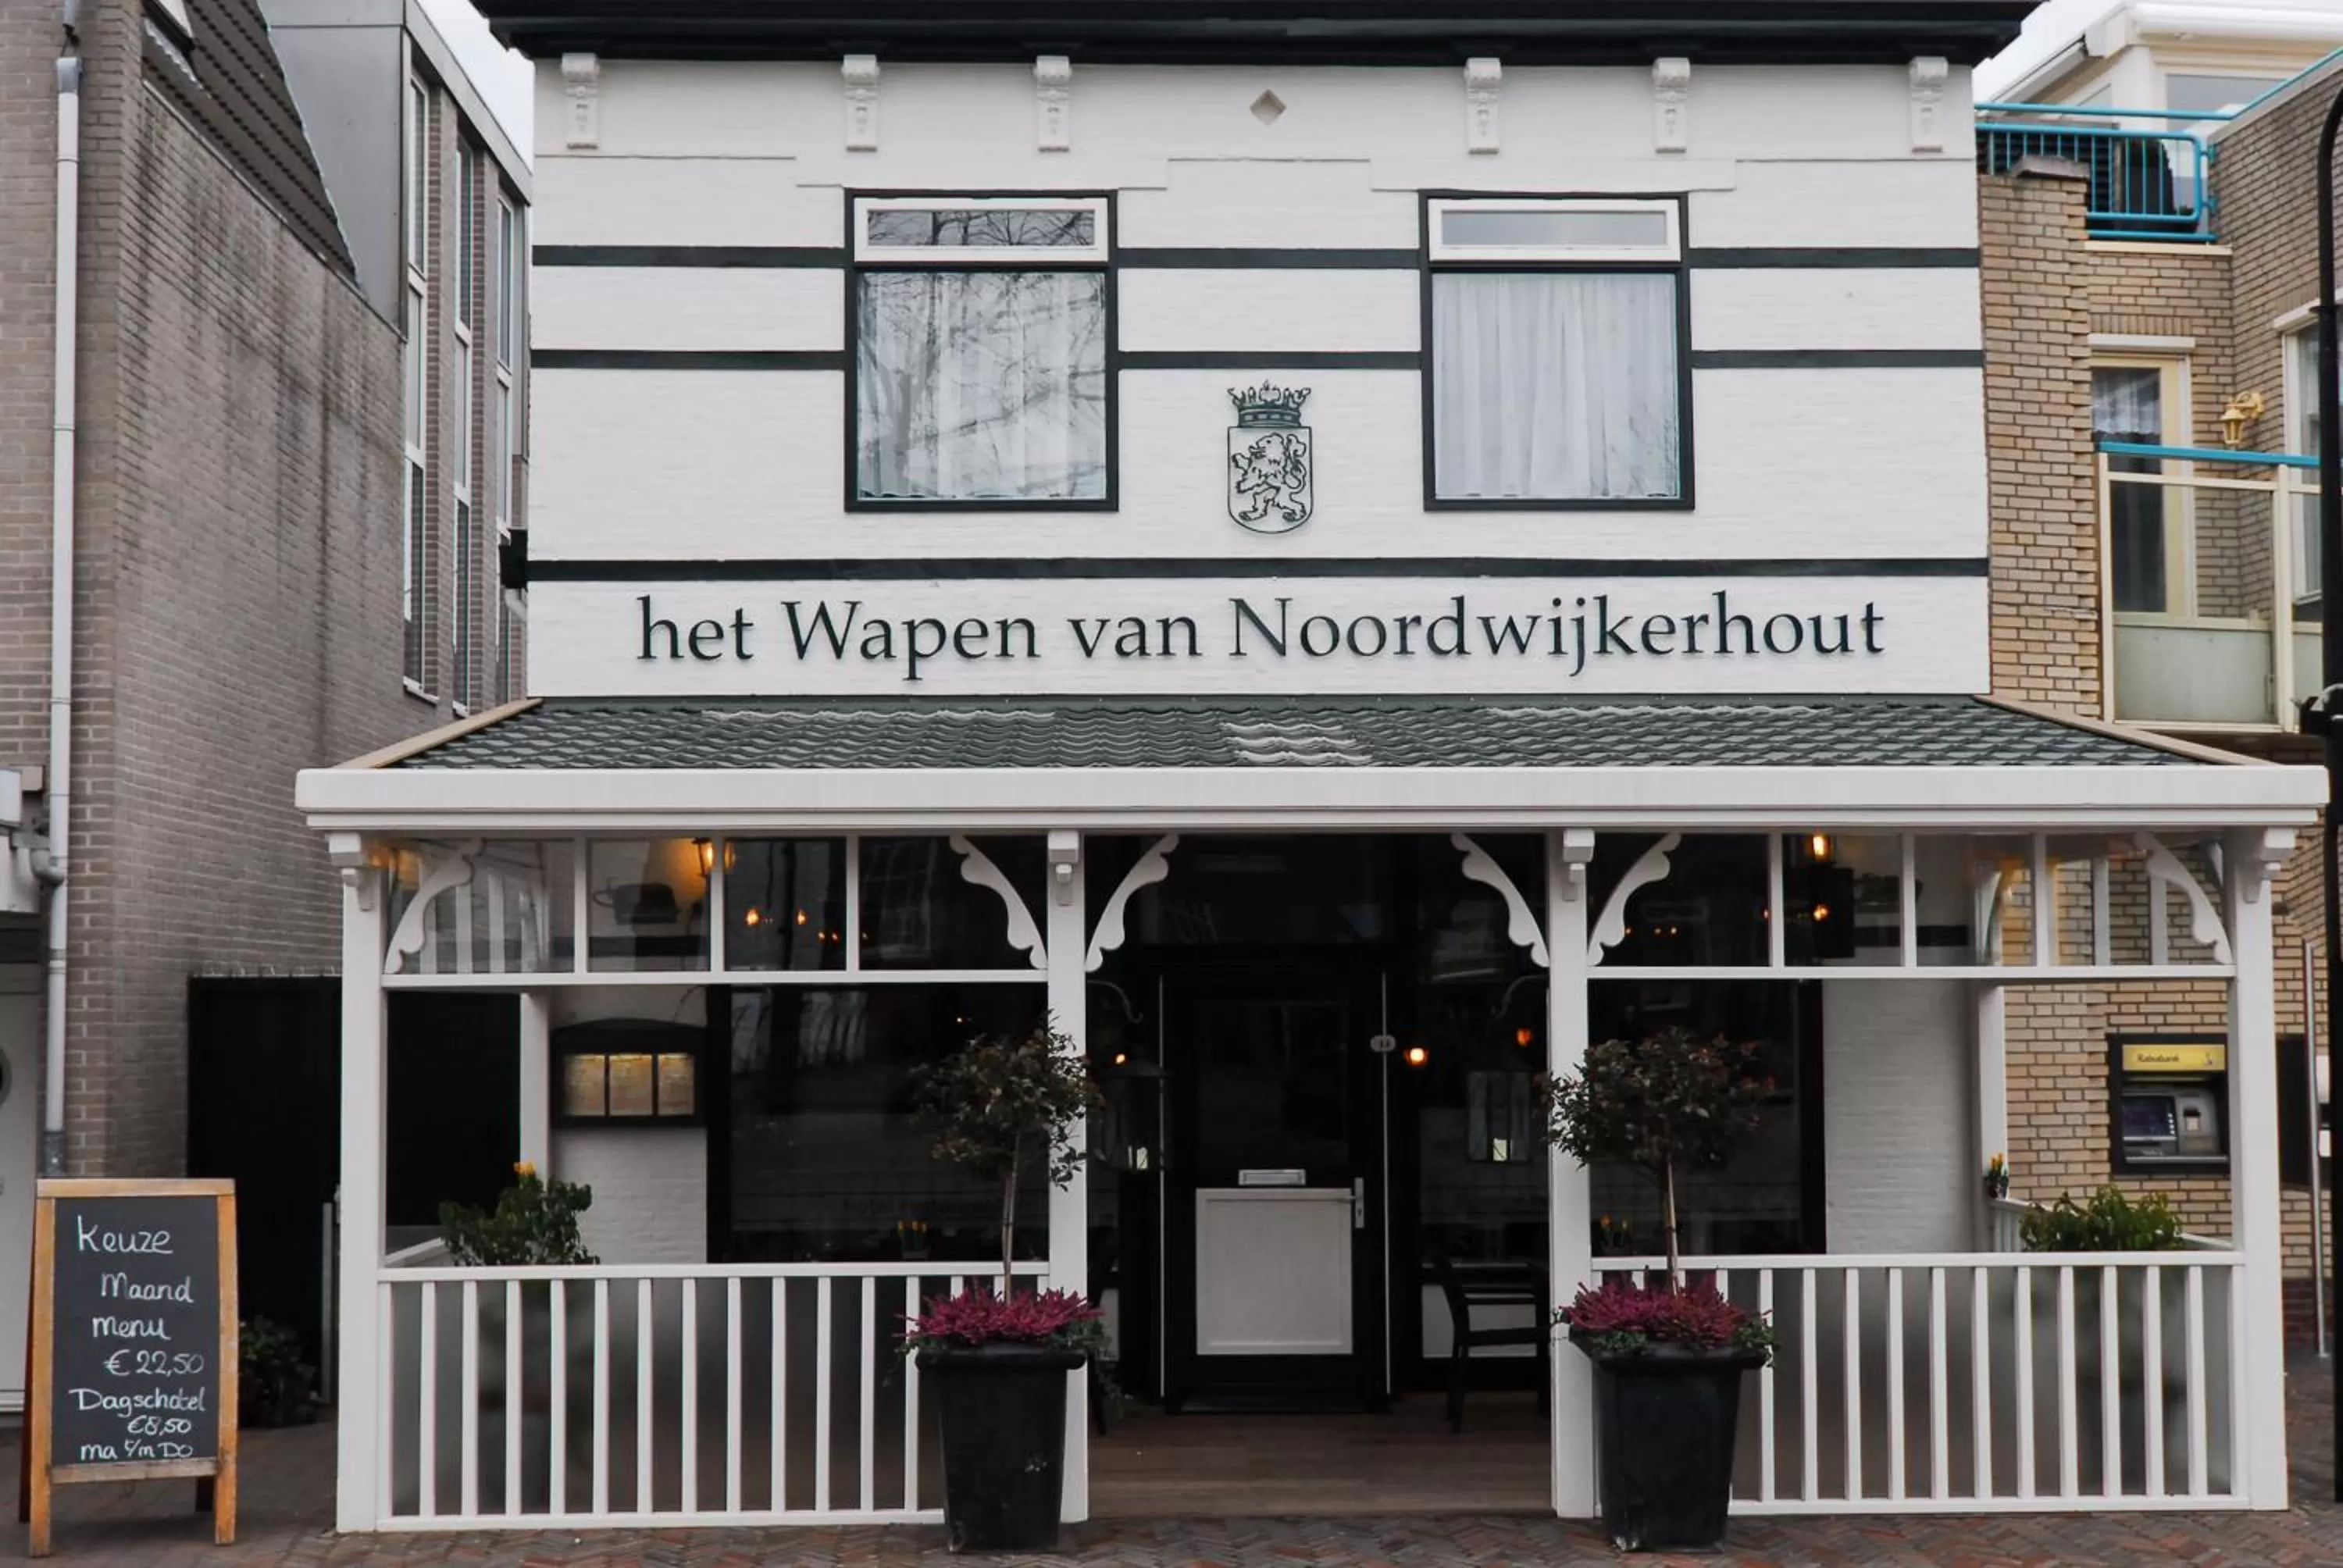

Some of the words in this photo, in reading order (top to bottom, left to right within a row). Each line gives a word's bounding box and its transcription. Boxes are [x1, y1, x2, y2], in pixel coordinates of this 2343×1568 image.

[637, 595, 753, 660] het
[781, 600, 1040, 681] Wapen
[1068, 616, 1202, 658] van
[1229, 590, 1885, 676] Noordwijkerhout
[68, 1386, 205, 1417] Dagschotel
